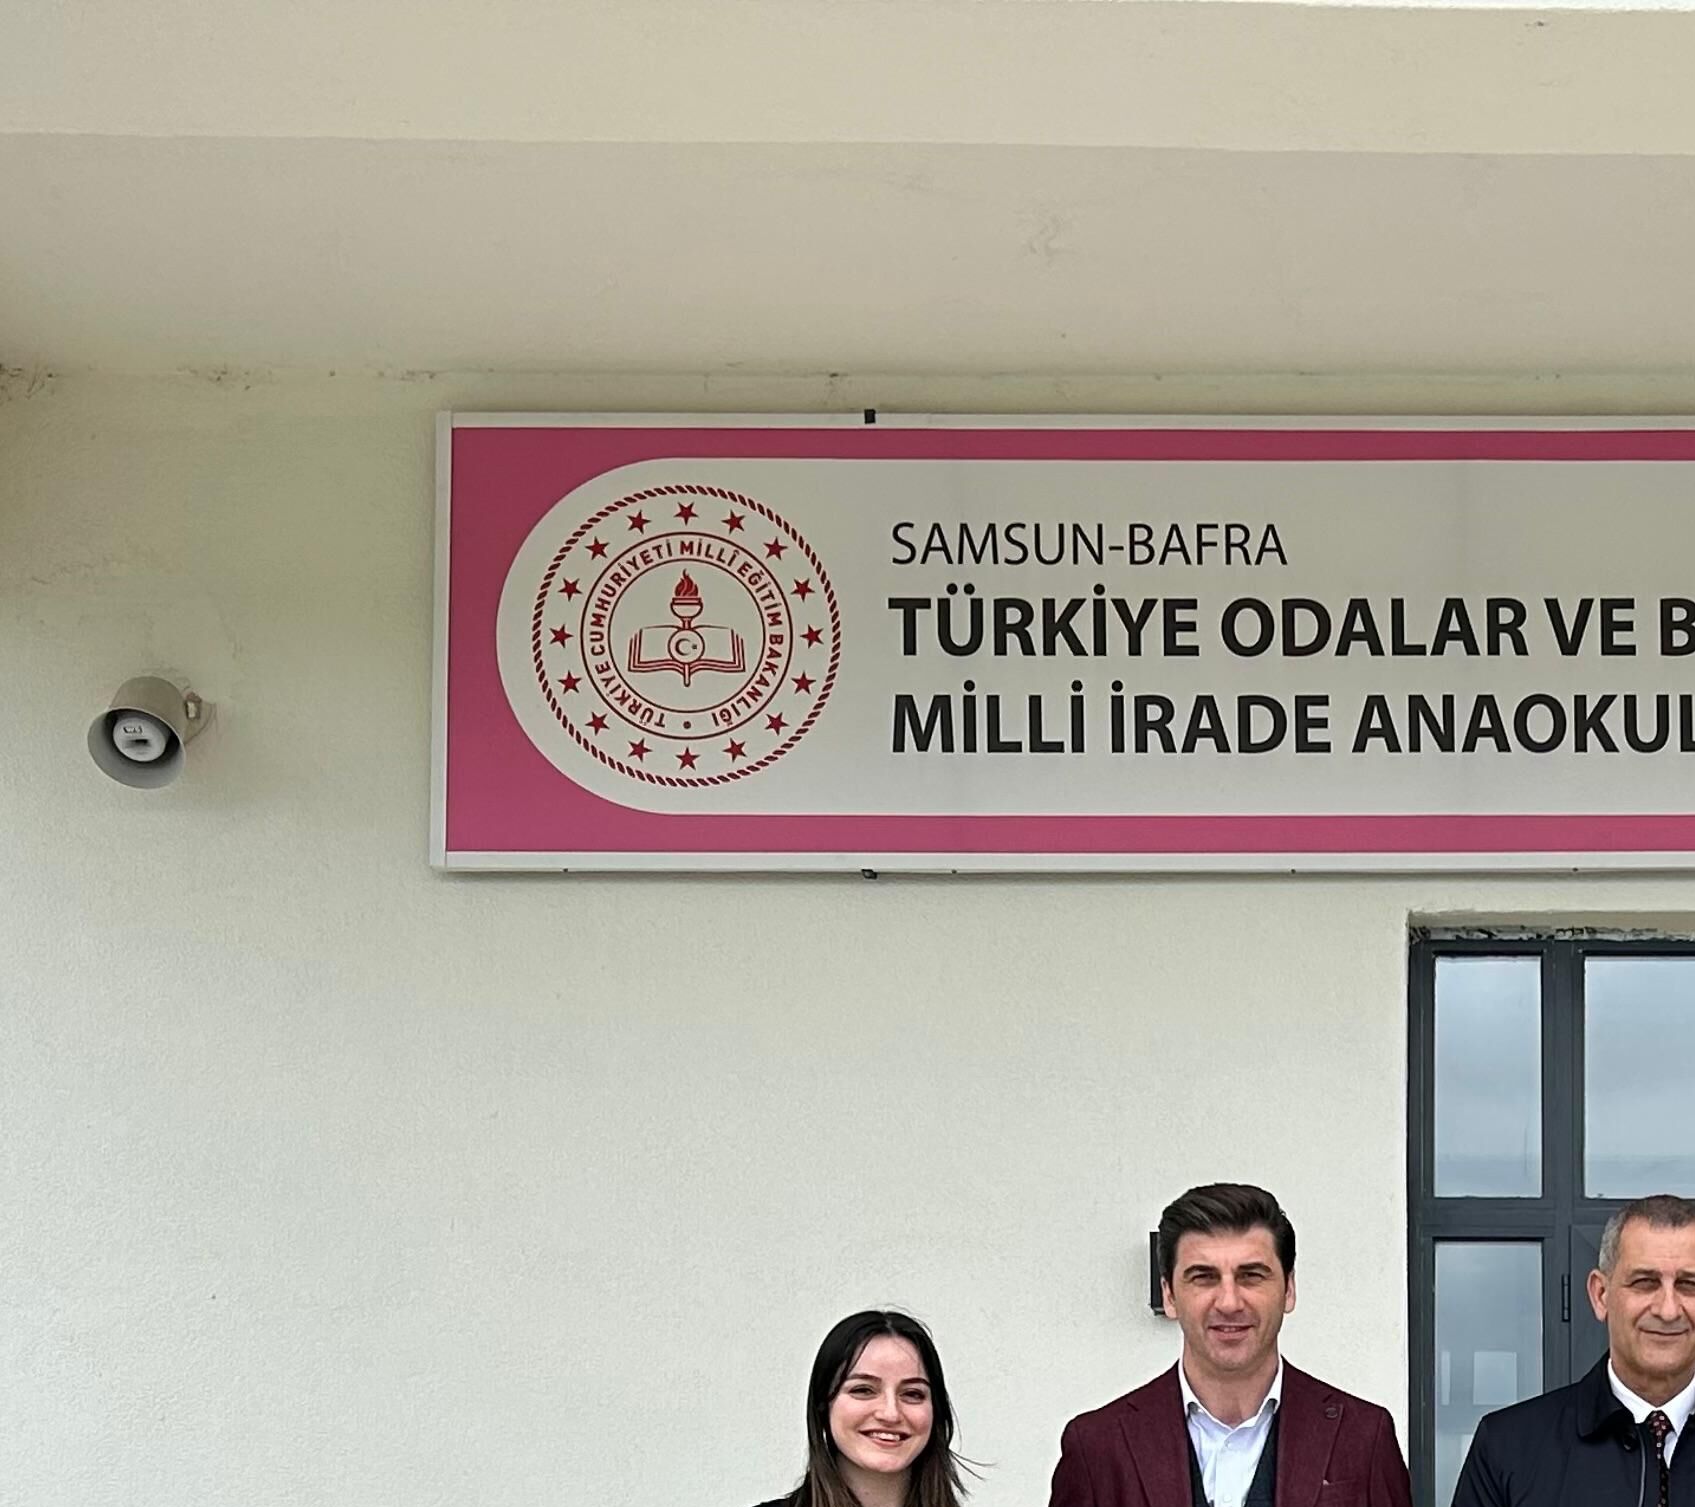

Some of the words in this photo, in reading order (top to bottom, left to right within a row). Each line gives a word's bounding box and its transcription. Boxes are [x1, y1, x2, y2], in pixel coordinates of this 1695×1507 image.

[891, 522, 1288, 566] SAMSUN-BAFRA
[589, 539, 673, 657] CUMHURİYETİ
[736, 561, 783, 627] EĞİTİM
[887, 582, 1200, 657] TÜRKİYE
[1220, 597, 1529, 658] ODALAR
[1543, 597, 1637, 657] VE
[595, 661, 665, 728] TÜRKİYE
[711, 633, 784, 727] BAKANLIĞI
[892, 680, 1085, 754] MİLLİ
[1110, 680, 1332, 754] İRADE
